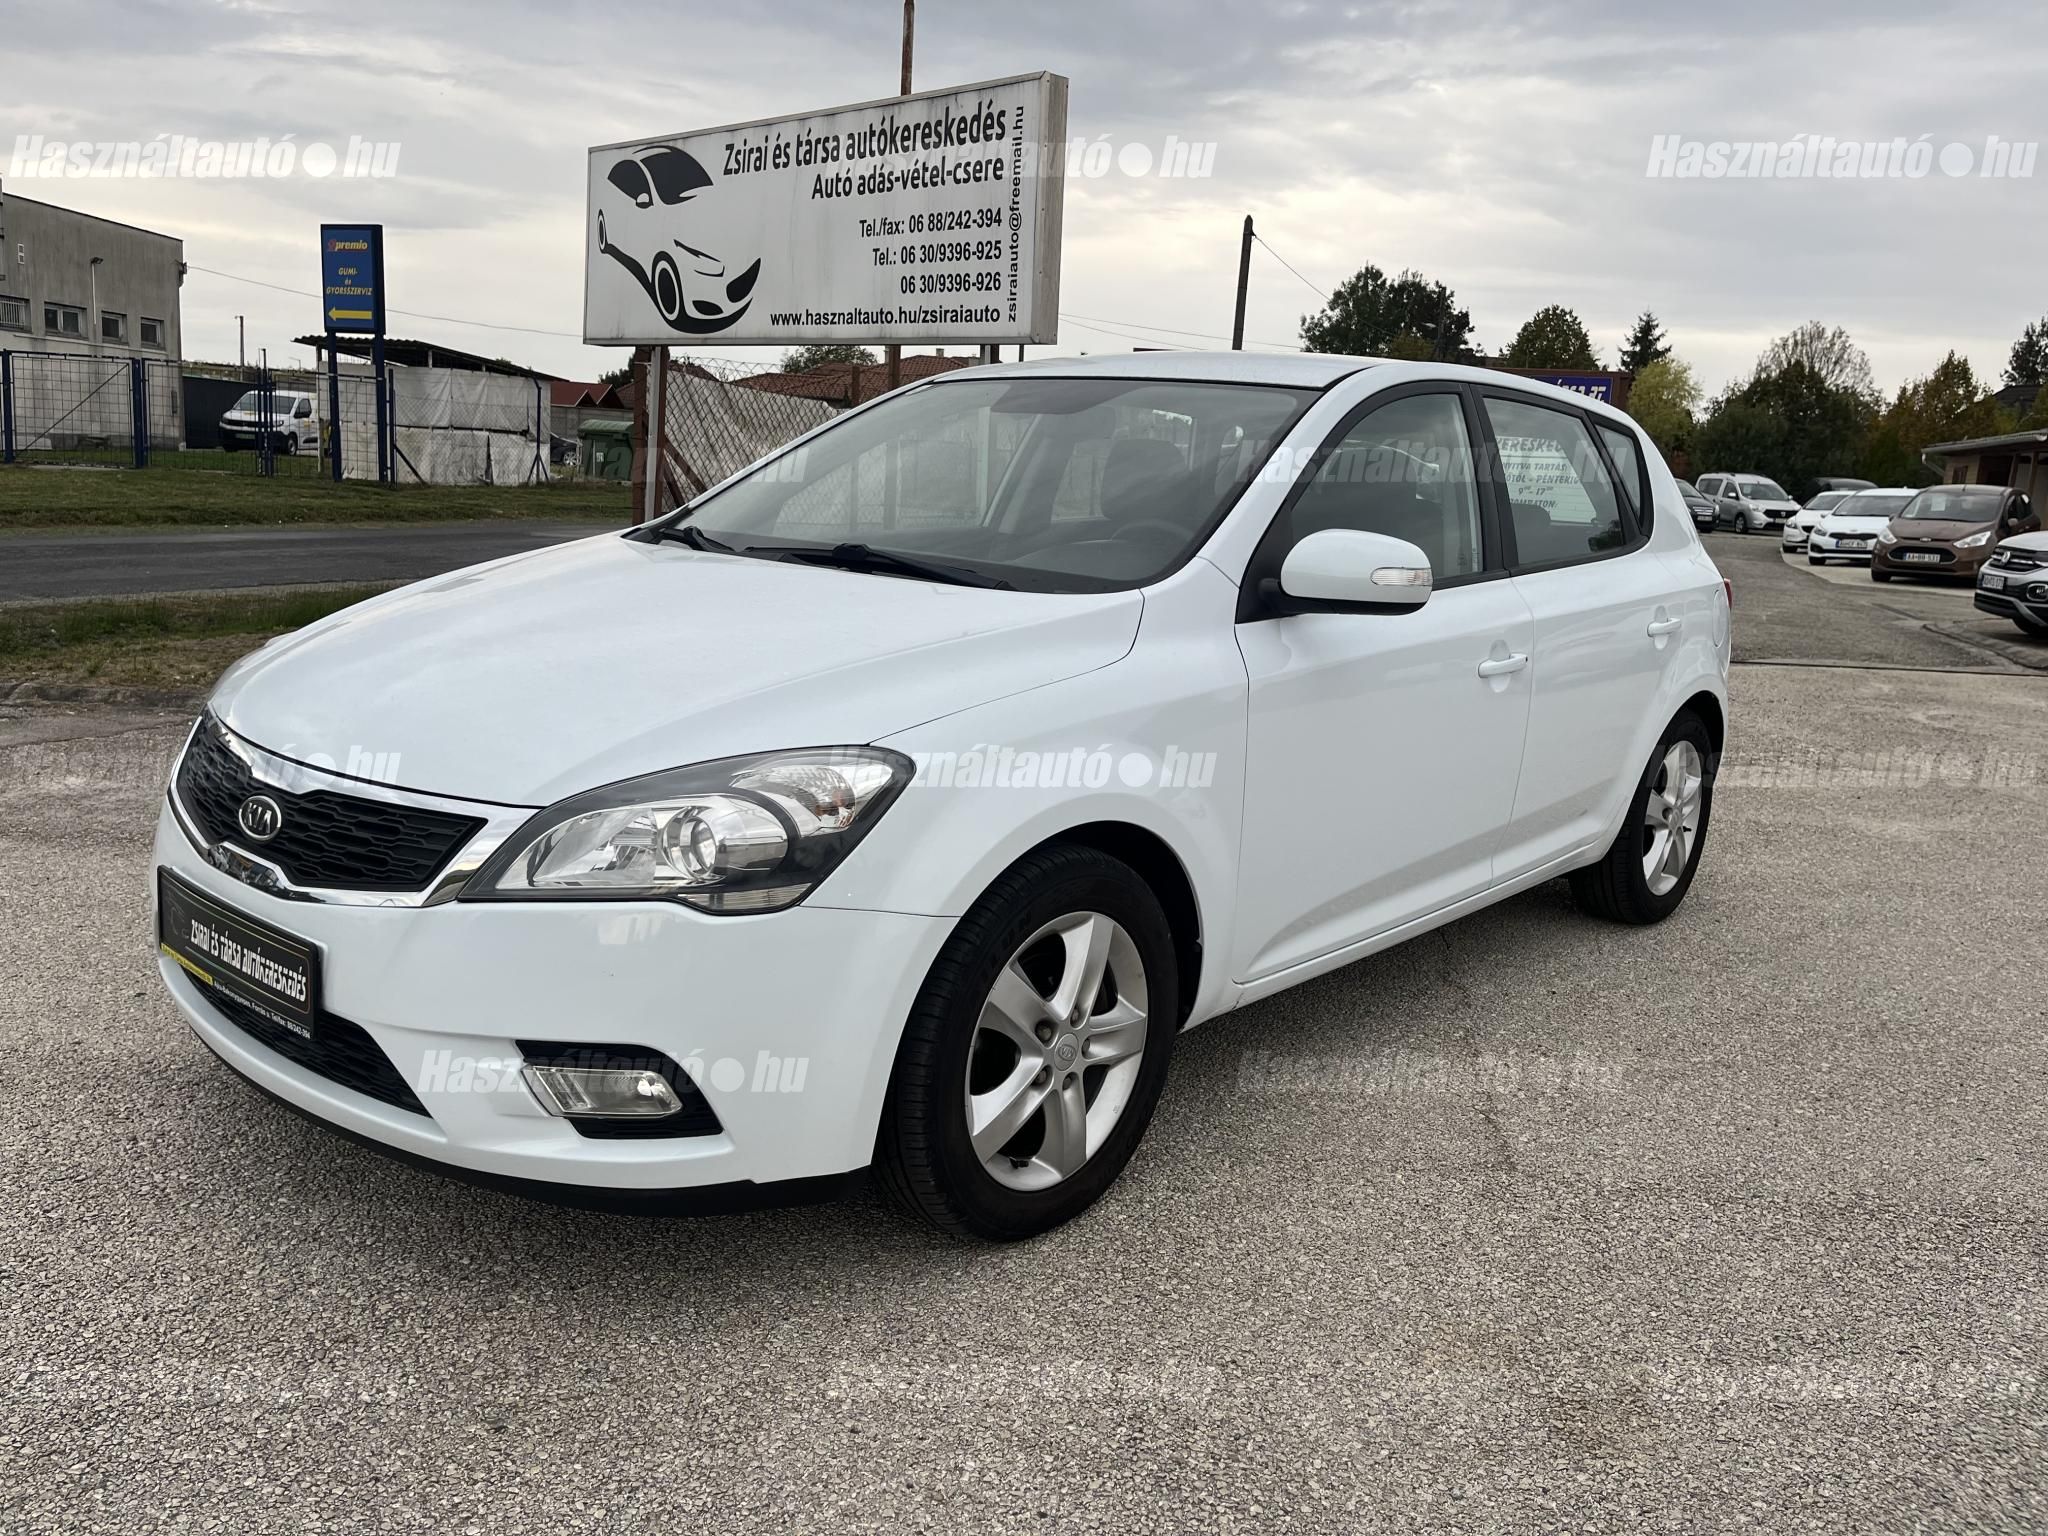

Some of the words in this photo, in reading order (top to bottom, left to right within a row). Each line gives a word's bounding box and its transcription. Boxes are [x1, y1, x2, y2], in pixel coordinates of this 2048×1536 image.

[723, 135, 769, 175] Zsirai
[772, 132, 791, 169] és
[795, 127, 840, 167] társa
[846, 98, 1007, 160] autókereskedés
[811, 167, 853, 200] Autó
[857, 155, 1005, 195] adás-vétel-csere
[859, 216, 905, 238] Tel./fax:
[909, 214, 924, 233] 06
[927, 207, 1002, 232] 88/242-394
[1008, 106, 1025, 323] zsiraiauto@freemail.hu
[335, 240, 368, 251] premio
[872, 247, 897, 266] Tel.:
[900, 245, 916, 265] 06
[919, 240, 1002, 263] 30/9396-925
[338, 267, 358, 276] GUMI-
[900, 275, 916, 294] 06
[919, 272, 1002, 293] 30/9396-926
[326, 286, 373, 296] GYORSSZERVIZ
[770, 304, 1001, 326] www.hasznaltauto.hu/zsiraiauto
[246, 802, 272, 834] KIA
[190, 919, 210, 952] ZSIRAI
[220, 930, 242, 970] TÁRSA
[242, 946, 306, 1002] AUTÓKERESKEDÉS
